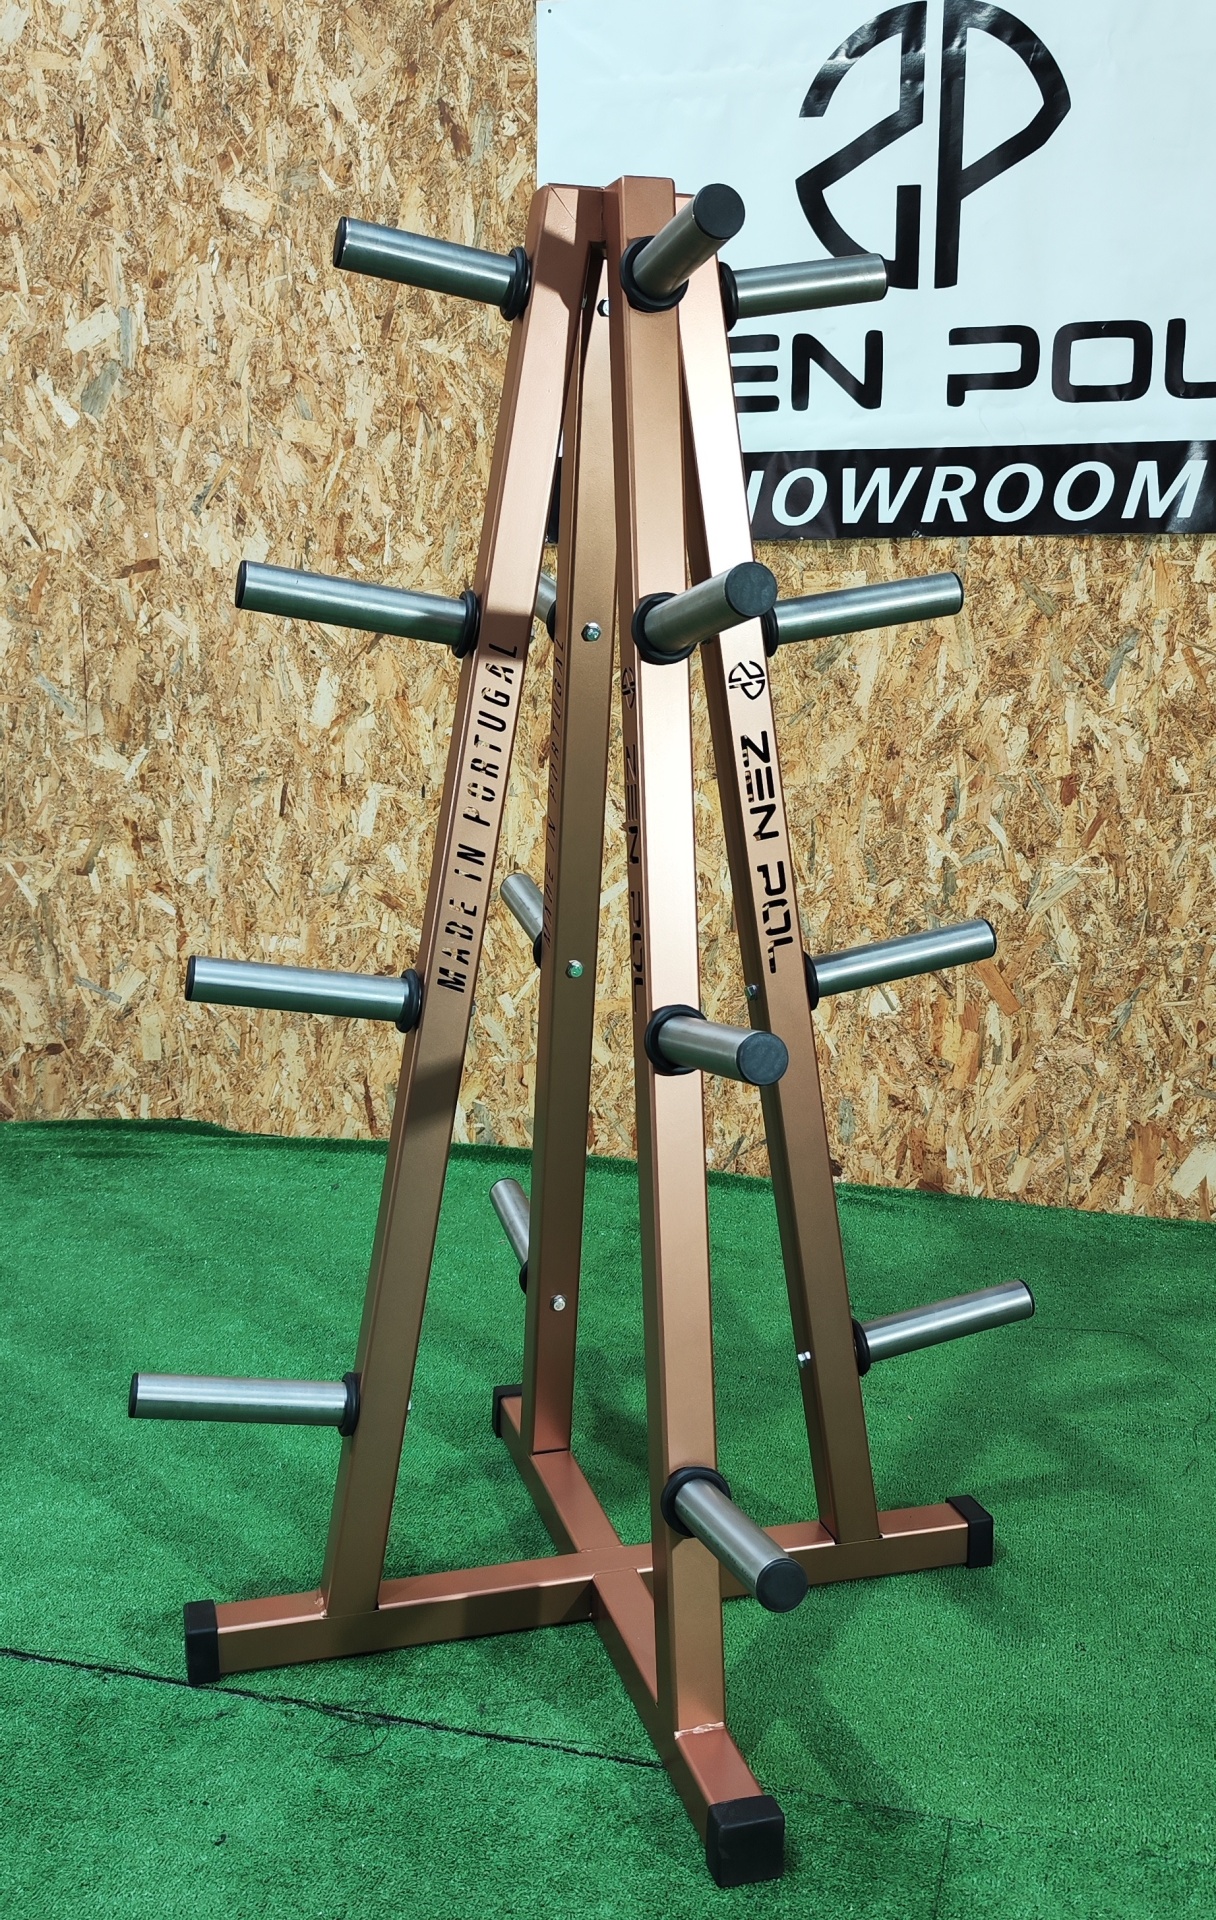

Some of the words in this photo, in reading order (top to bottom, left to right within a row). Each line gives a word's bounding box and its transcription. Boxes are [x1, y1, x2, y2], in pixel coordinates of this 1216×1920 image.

[728, 329, 884, 414] EN
[946, 317, 1216, 408] POL
[747, 459, 1208, 527] OWROOM
[462, 643, 518, 827] PORTUGAL
[739, 730, 780, 842] ZEN
[454, 842, 486, 882] IN
[437, 897, 478, 994] MADE
[756, 860, 794, 974] POL
